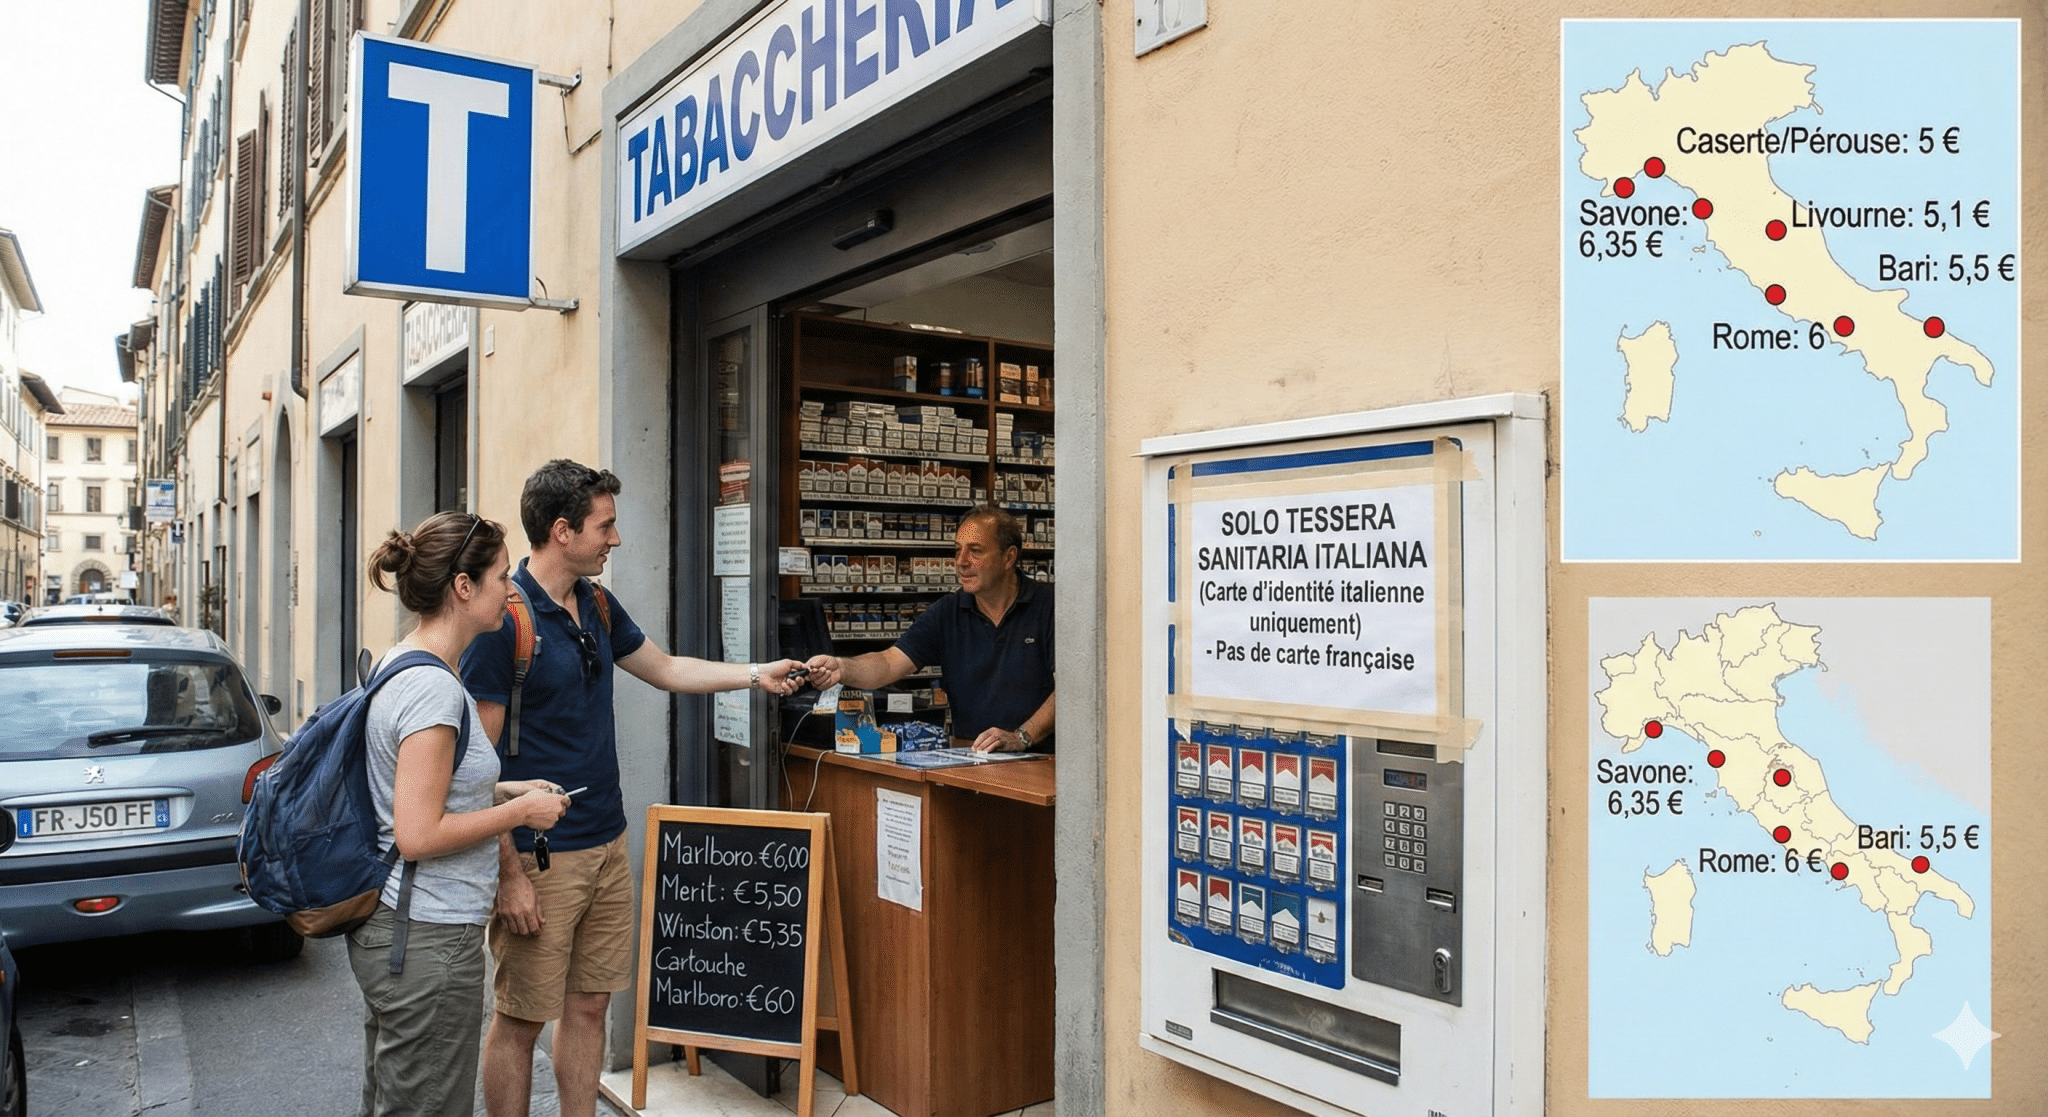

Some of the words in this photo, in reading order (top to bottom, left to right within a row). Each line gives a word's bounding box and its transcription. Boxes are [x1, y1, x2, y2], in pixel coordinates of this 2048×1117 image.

[388, 62, 509, 274] T
[1221, 509, 1279, 536] SOLO
[1286, 503, 1396, 534] TESSERA
[1198, 543, 1309, 571] SANITARIA
[1315, 540, 1428, 569] ITALIANA
[1199, 580, 1248, 606] (Carte
[1341, 580, 1425, 603] italienne
[1250, 611, 1362, 641] uniquement)
[1216, 640, 1246, 661] Pas
[1250, 641, 1271, 663] de
[1276, 644, 1321, 665] carte
[1326, 644, 1415, 674] française
[125, 803, 153, 826] FF
[662, 873, 725, 903] Merit:
[733, 880, 802, 911] €5,50
[655, 946, 748, 977] Cartouche
